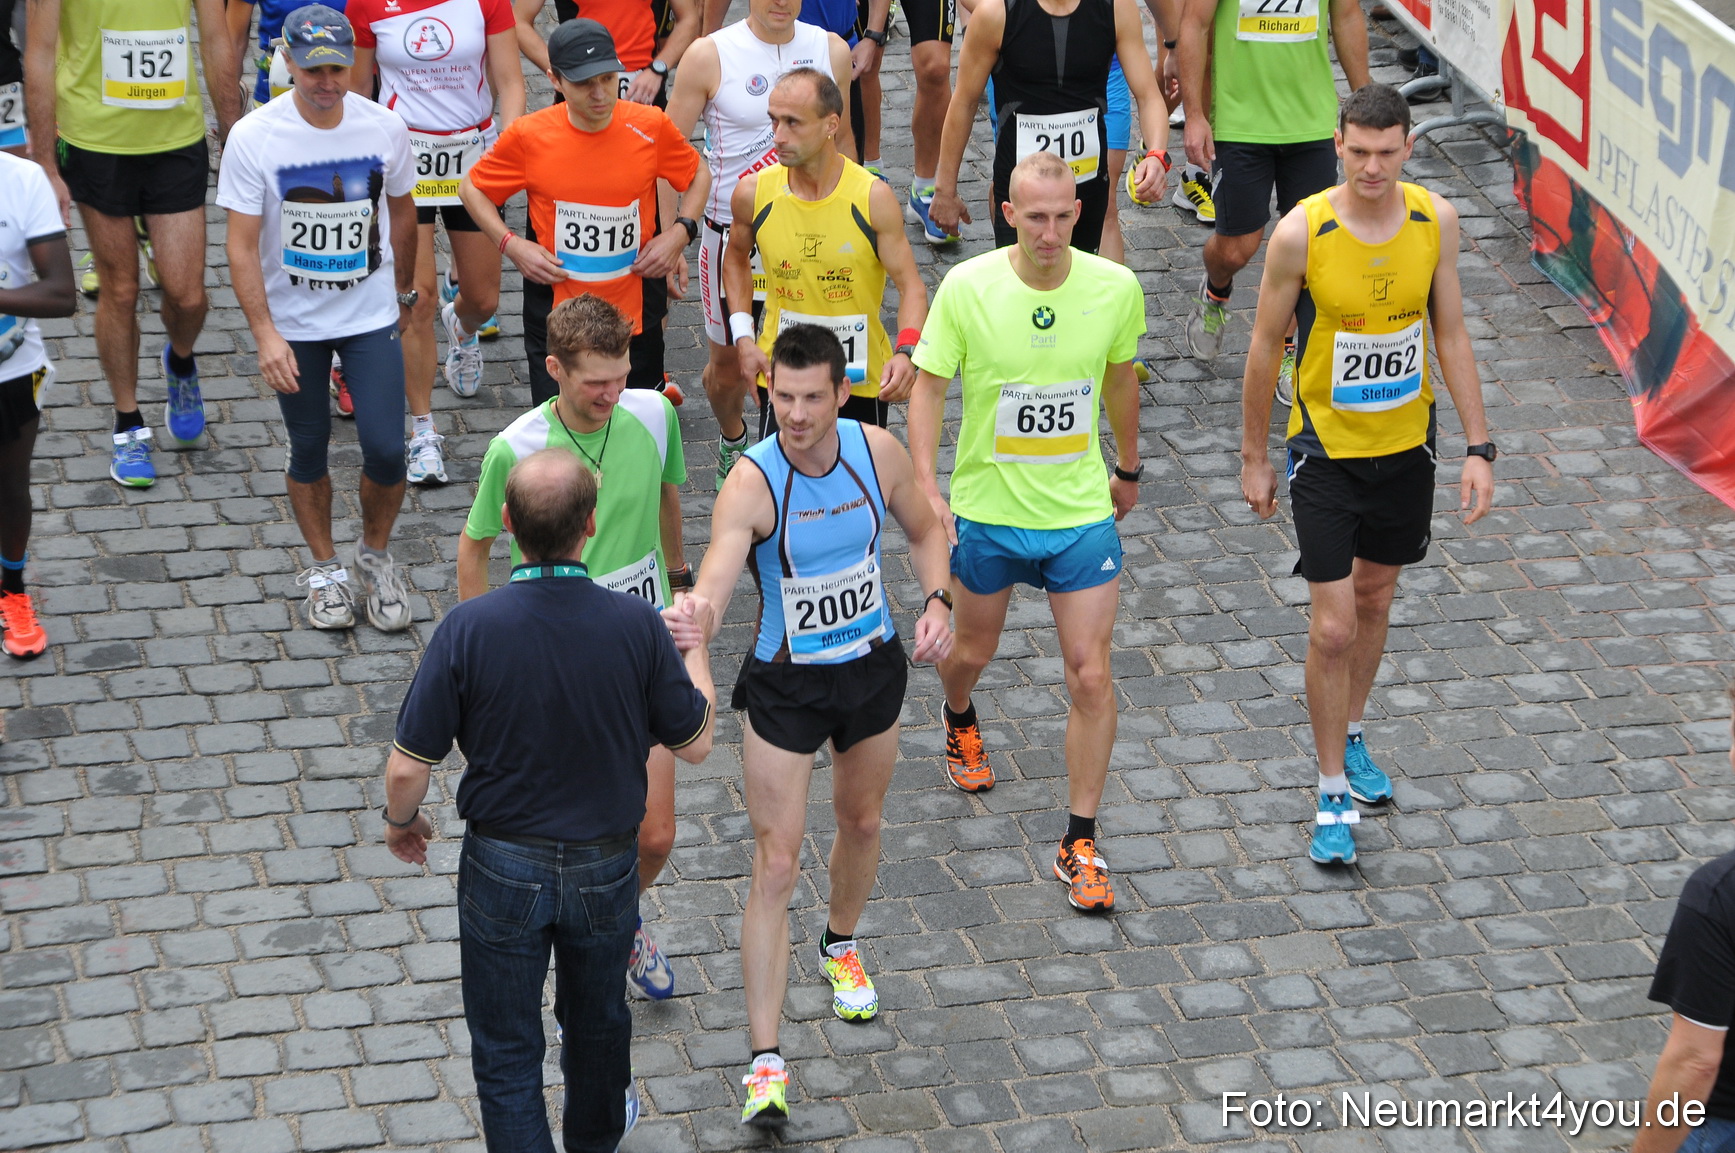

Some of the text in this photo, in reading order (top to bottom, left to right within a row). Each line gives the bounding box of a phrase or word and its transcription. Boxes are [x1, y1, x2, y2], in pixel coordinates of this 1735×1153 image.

[1259, 20, 1300, 31] Richard
[103, 36, 174, 47] PARTL Neumarkt
[120, 49, 173, 78] 152
[127, 85, 166, 99] Jürgen
[1019, 118, 1085, 130] PARTL Neumarkt
[409, 139, 469, 149] ARTL Neumarkt
[1035, 130, 1085, 159] 210
[416, 150, 463, 177] 301
[283, 208, 358, 219] PARTL Neumarkt
[558, 208, 630, 222] PARTL Neumarkt
[291, 221, 363, 251] 2013
[564, 222, 635, 252] 3318
[294, 254, 358, 270] Hans-Peter
[700, 245, 721, 325] memmert
[1341, 318, 1366, 327] Seidl
[1031, 334, 1056, 344] Partl
[1336, 335, 1412, 350] PARTL Neumarkt
[1343, 344, 1417, 381] 2062
[1002, 389, 1078, 401] PARTL Neumarkt
[1361, 386, 1401, 400] Stefan
[1017, 401, 1075, 433] 635
[607, 567, 648, 590] Neumarkt
[784, 571, 866, 596] PARTL Neumarkt
[795, 581, 875, 630] 2002
[821, 626, 861, 648] Marco
